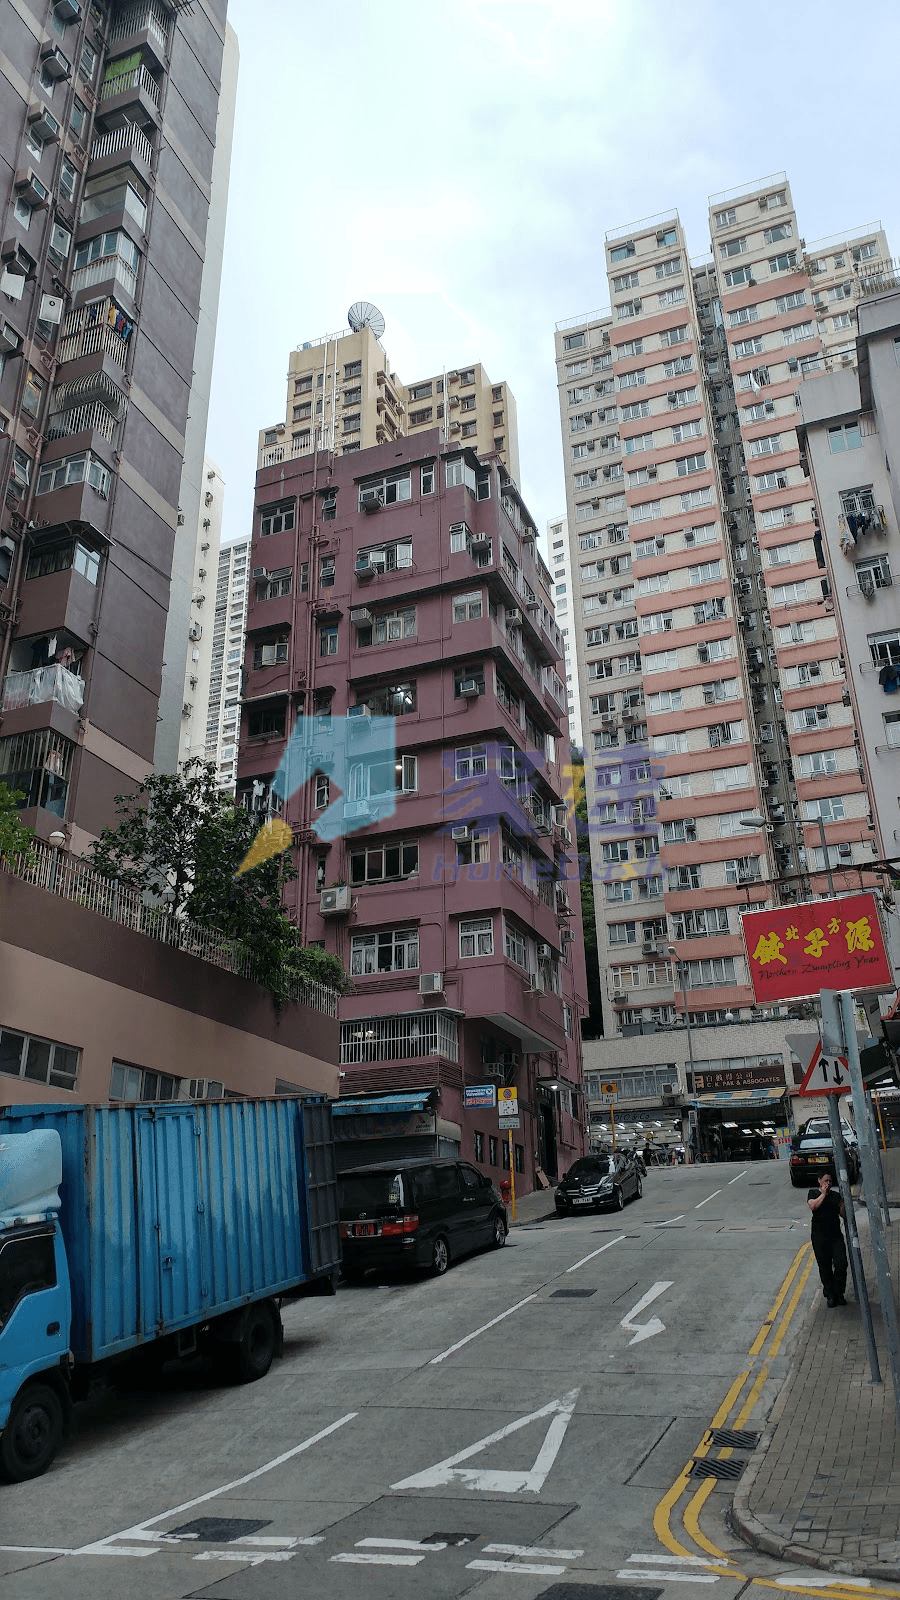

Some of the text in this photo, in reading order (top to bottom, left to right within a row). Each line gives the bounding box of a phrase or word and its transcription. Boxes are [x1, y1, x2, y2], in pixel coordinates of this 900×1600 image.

[758, 955, 881, 981] Northern Dumpling Yuan
[742, 1076, 781, 1085] ASSOCIATES
